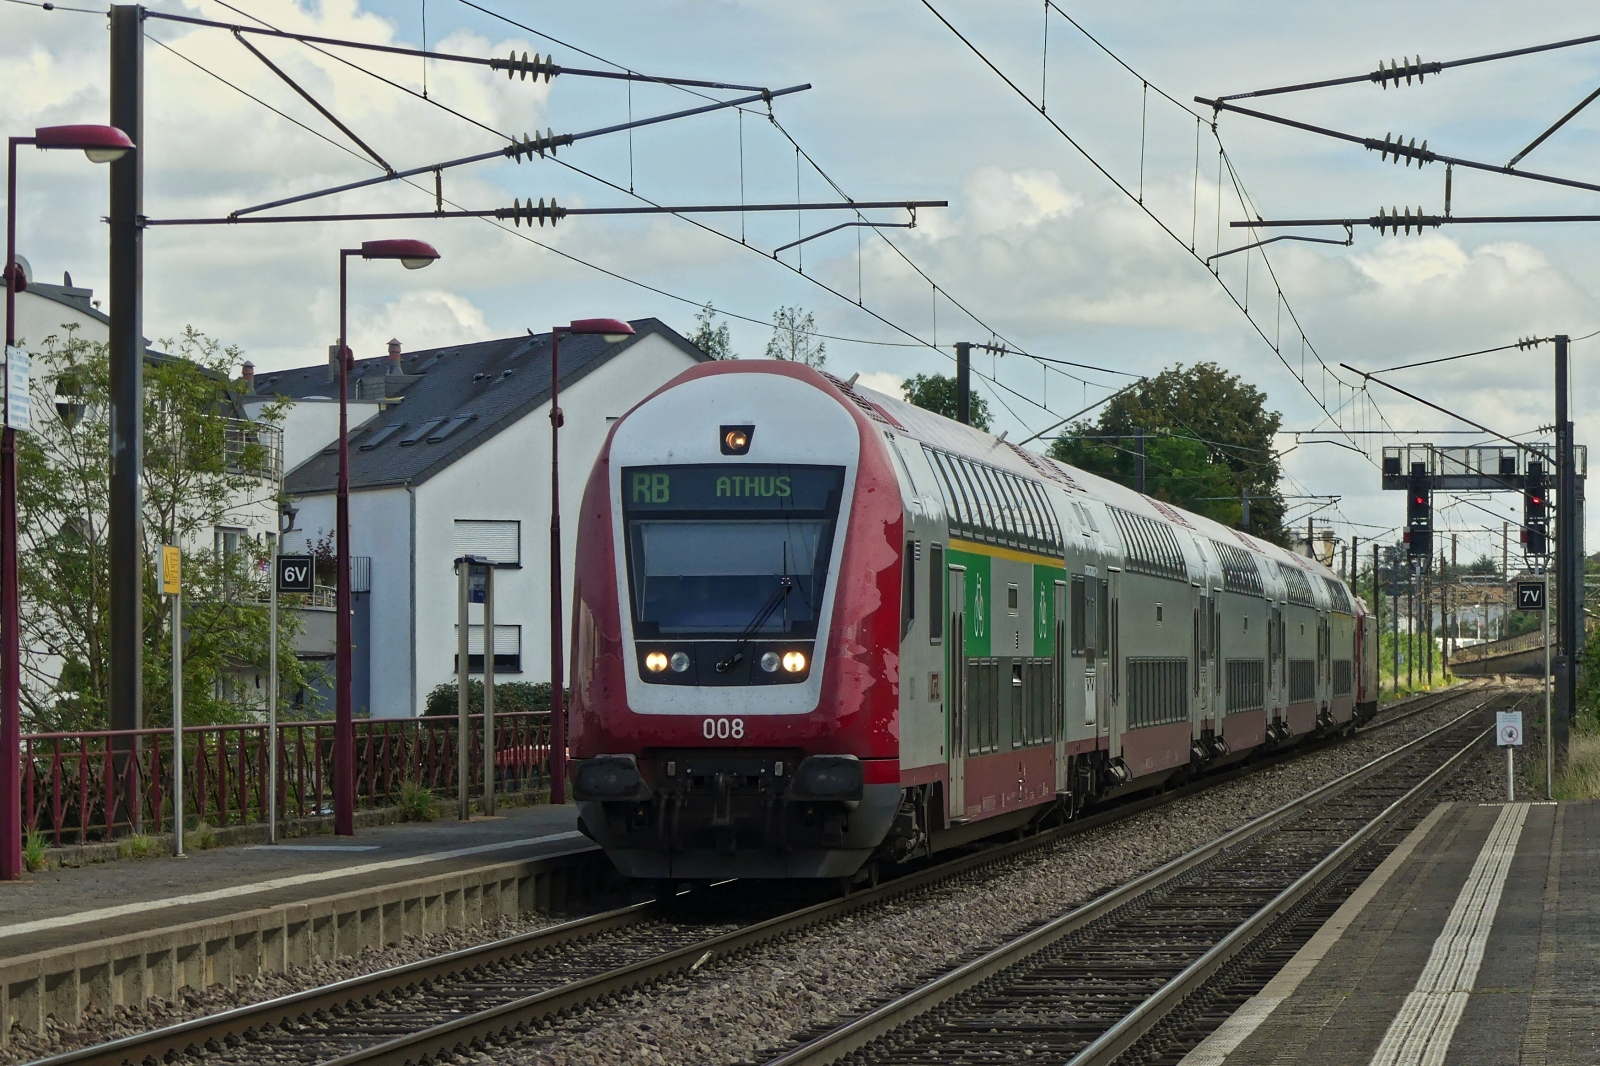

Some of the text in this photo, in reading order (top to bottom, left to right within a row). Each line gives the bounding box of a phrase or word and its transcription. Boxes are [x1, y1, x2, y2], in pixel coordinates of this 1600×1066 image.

[632, 473, 791, 502] RB ATHUS
[284, 567, 307, 582] 6V
[1521, 590, 1540, 602] 7V
[703, 718, 744, 739] 008
